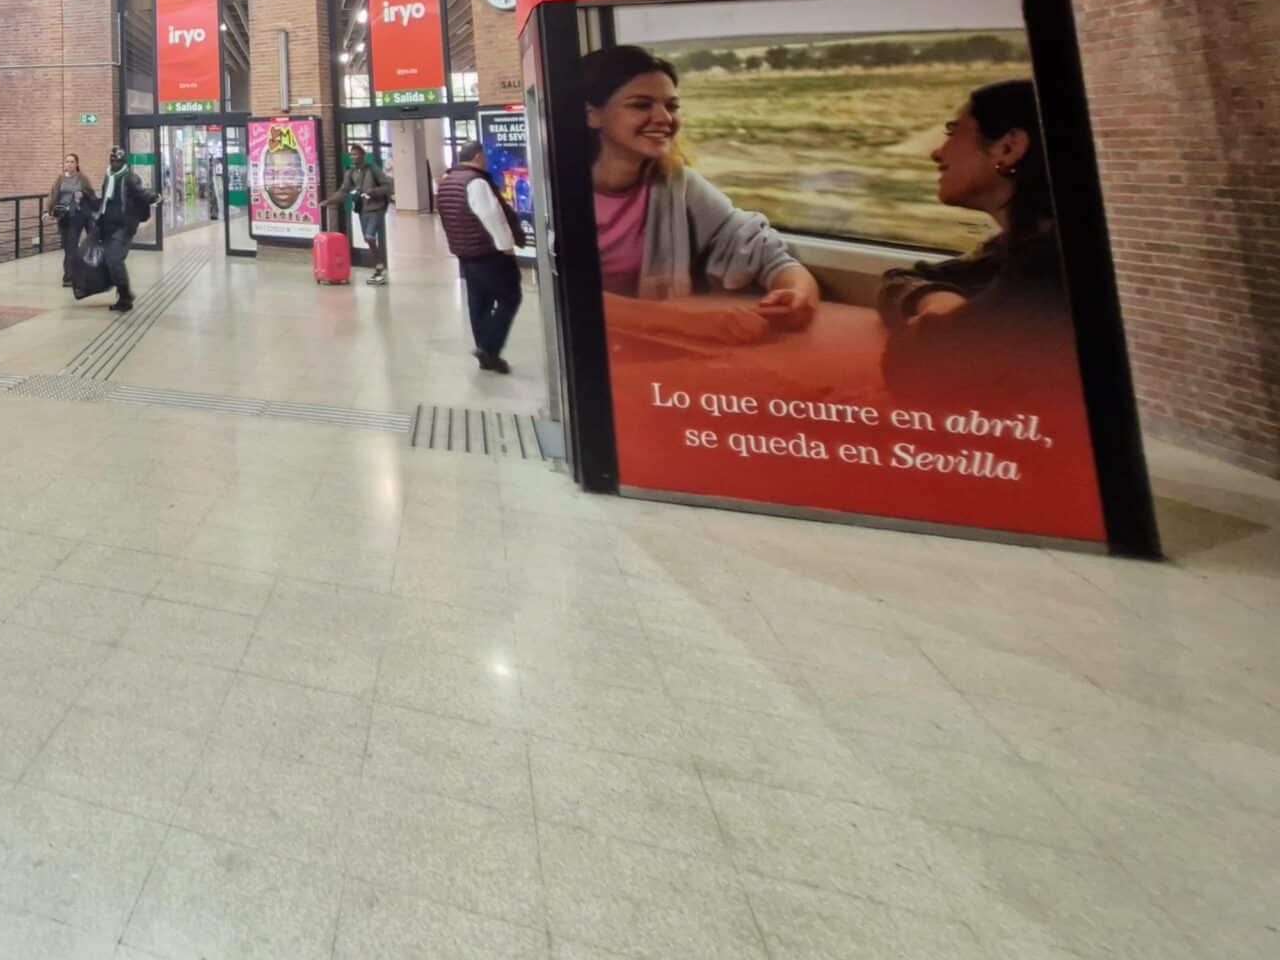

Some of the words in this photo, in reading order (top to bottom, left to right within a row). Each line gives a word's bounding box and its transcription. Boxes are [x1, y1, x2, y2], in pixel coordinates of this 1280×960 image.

[382, 0, 426, 27] iryo
[168, 24, 206, 48] iryo
[175, 101, 203, 112] Salida
[392, 91, 425, 104] Salida
[651, 382, 690, 408] Lo
[700, 392, 758, 416] que
[768, 399, 880, 427] ocurre
[891, 410, 936, 431] en
[945, 410, 1054, 448] abril,
[684, 428, 718, 447] se
[727, 433, 828, 461] queda
[838, 442, 882, 465] en
[890, 442, 1021, 480] Sevilla
